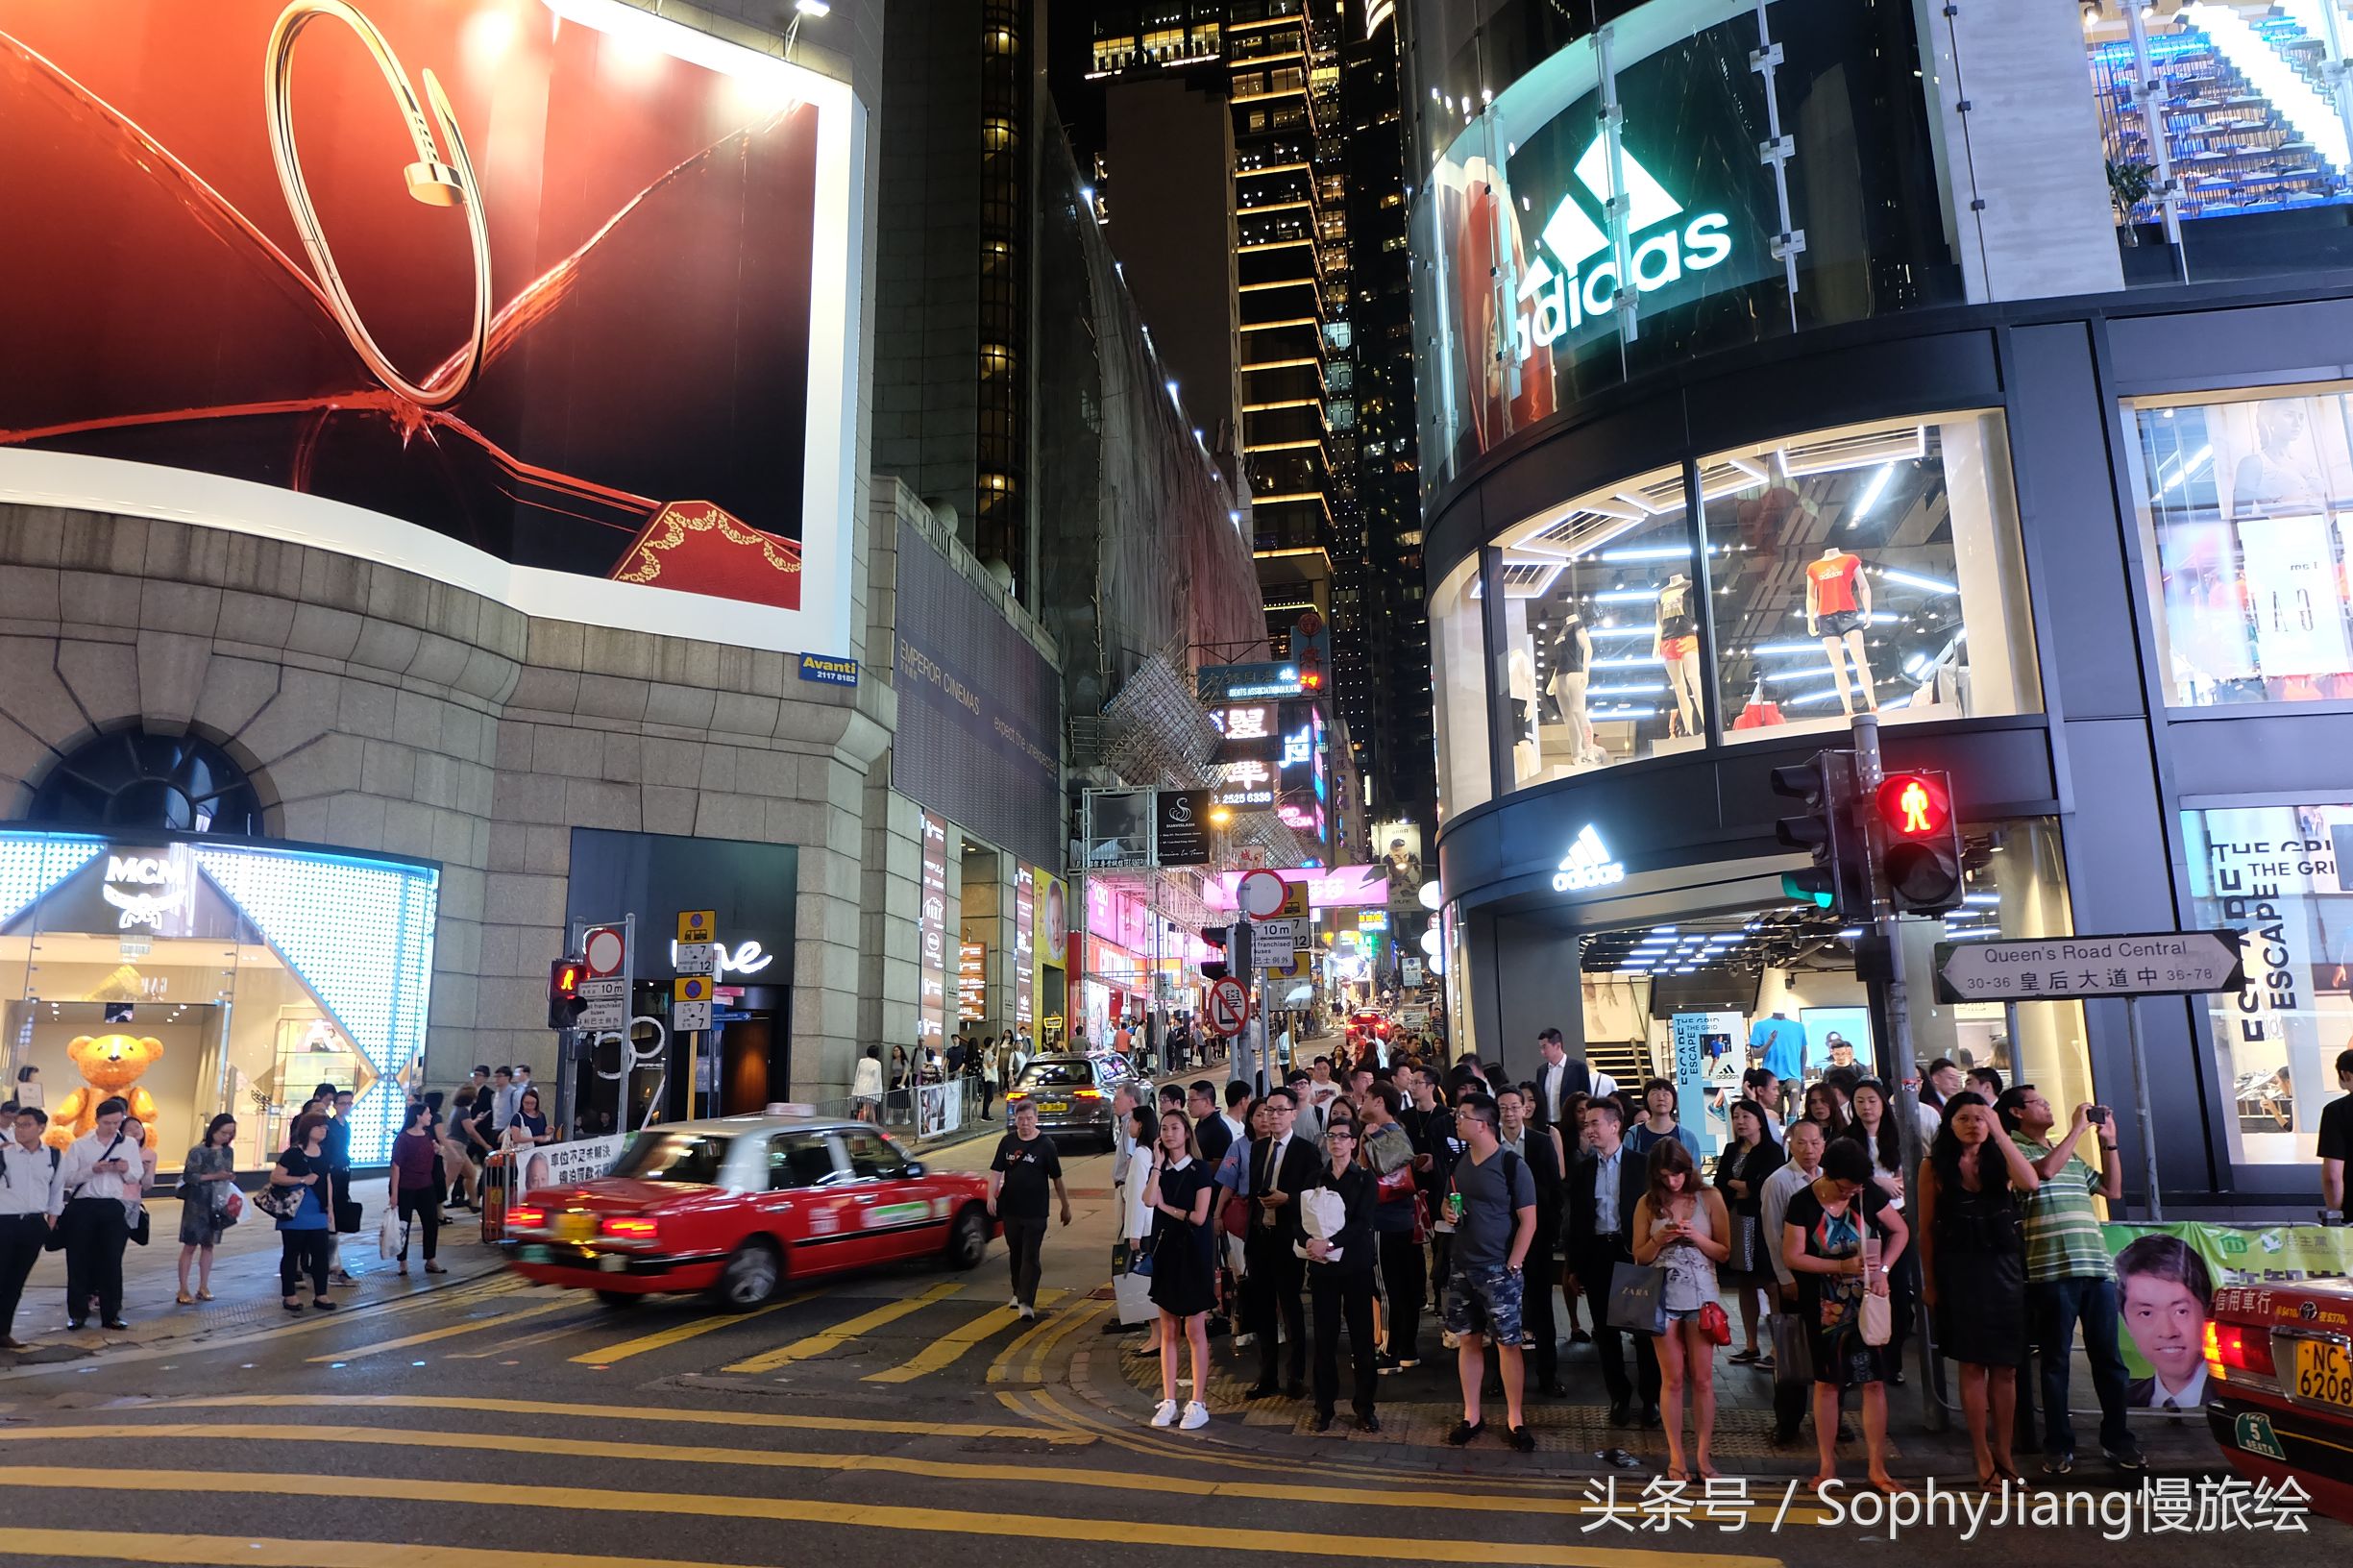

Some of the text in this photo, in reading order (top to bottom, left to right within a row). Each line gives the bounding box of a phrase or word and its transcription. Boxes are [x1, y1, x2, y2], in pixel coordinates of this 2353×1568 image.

[803, 656, 856, 674] Avanti
[817, 671, 836, 680] 2117
[900, 638, 980, 715] EMPEROR CINEMAS
[105, 855, 187, 885] MCM
[1552, 863, 1625, 893] adidas
[2247, 863, 2292, 877] THE
[1255, 924, 1289, 936] 10 m
[1292, 919, 1300, 929] 7
[699, 945, 707, 955] 7
[1294, 936, 1307, 946] 12
[2252, 883, 2297, 1010] ESCAPE
[1984, 941, 2187, 963] Queen's Road Central
[700, 962, 711, 970] 12
[601, 983, 613, 993] 10
[1967, 967, 2214, 992] 30-36 皇后大道中 36-78
[699, 1002, 706, 1014] 7
[699, 1018, 706, 1028] 7
[1687, 1033, 1699, 1074] ESCAPE
[2215, 1289, 2273, 1315] 信用車行
[2313, 1342, 2340, 1374] NC
[2300, 1368, 2353, 1406] 6208
[2249, 1422, 2261, 1441] 5
